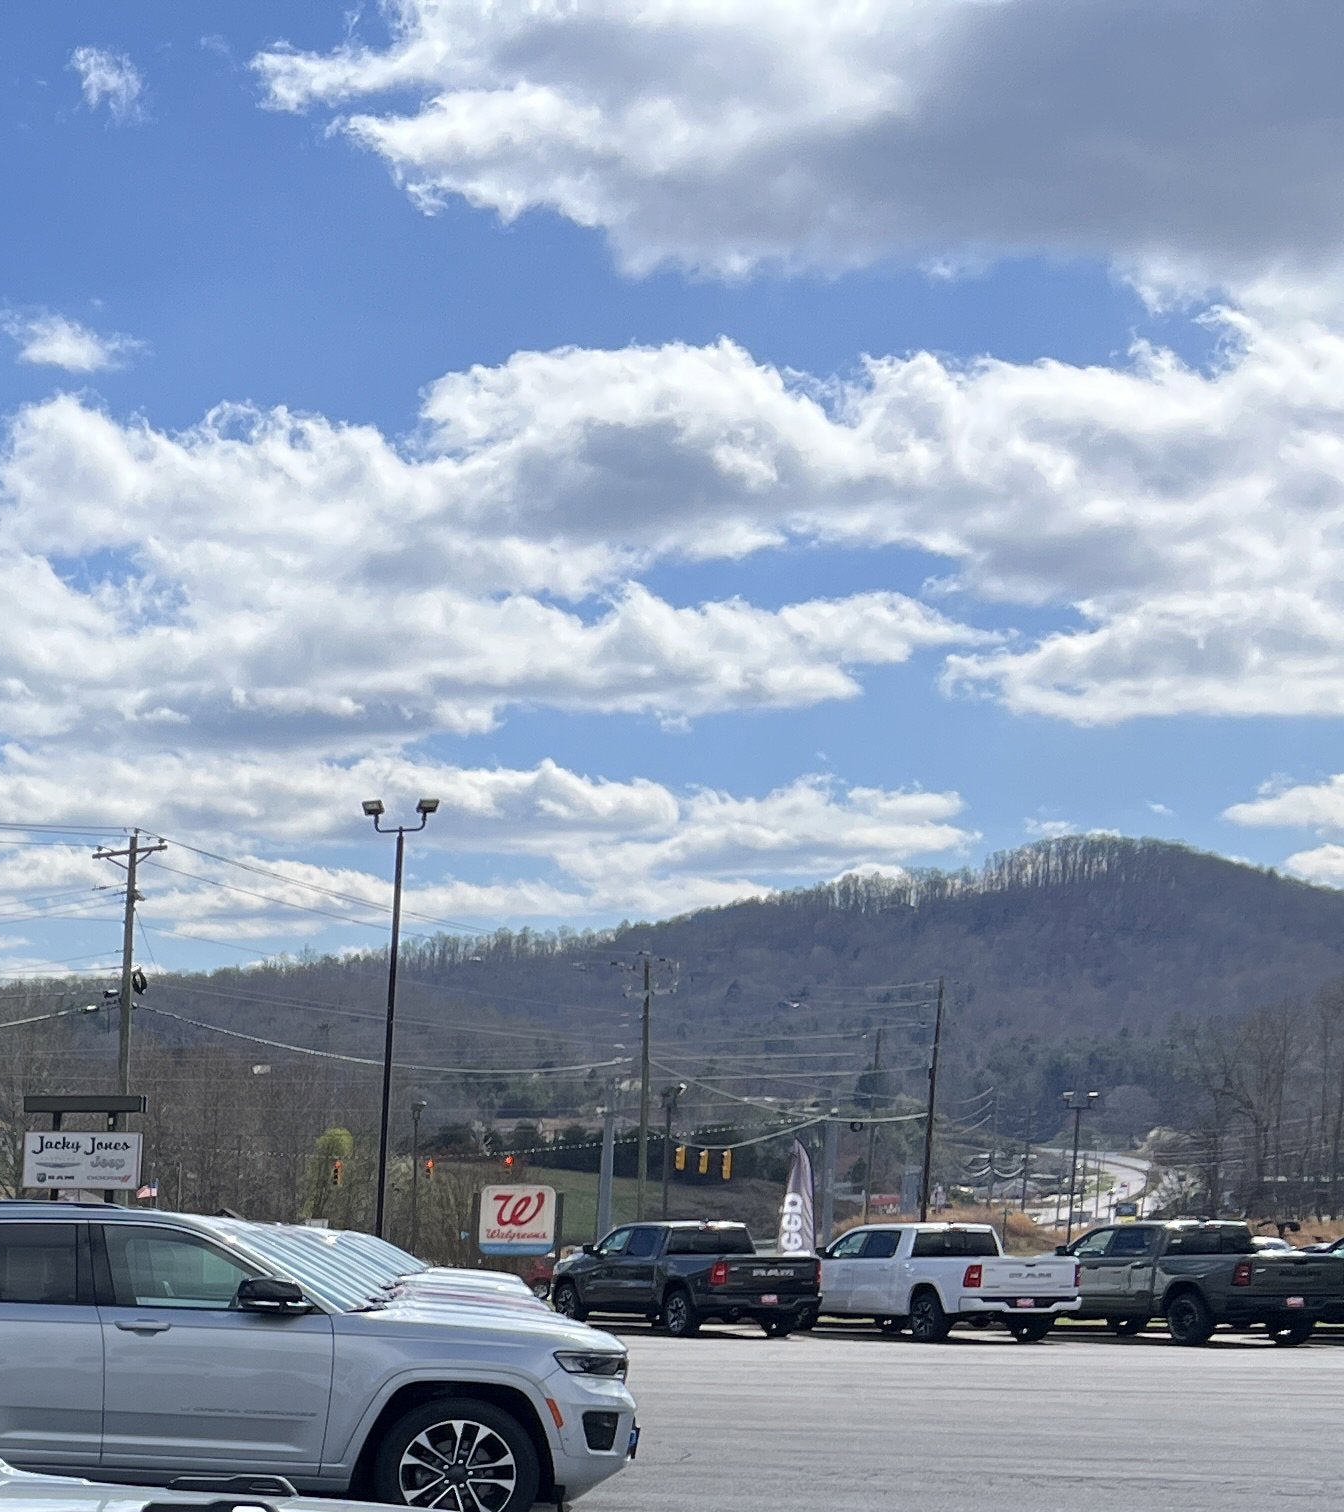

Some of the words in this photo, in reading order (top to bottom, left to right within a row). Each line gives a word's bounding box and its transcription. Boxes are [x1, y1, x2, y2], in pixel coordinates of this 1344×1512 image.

[32, 1135, 81, 1155] Jacky
[84, 1137, 131, 1156] Jones
[493, 1191, 545, 1227] W
[781, 1192, 808, 1257] eep
[486, 1229, 548, 1243] Walgreens
[752, 1268, 795, 1277] RAM
